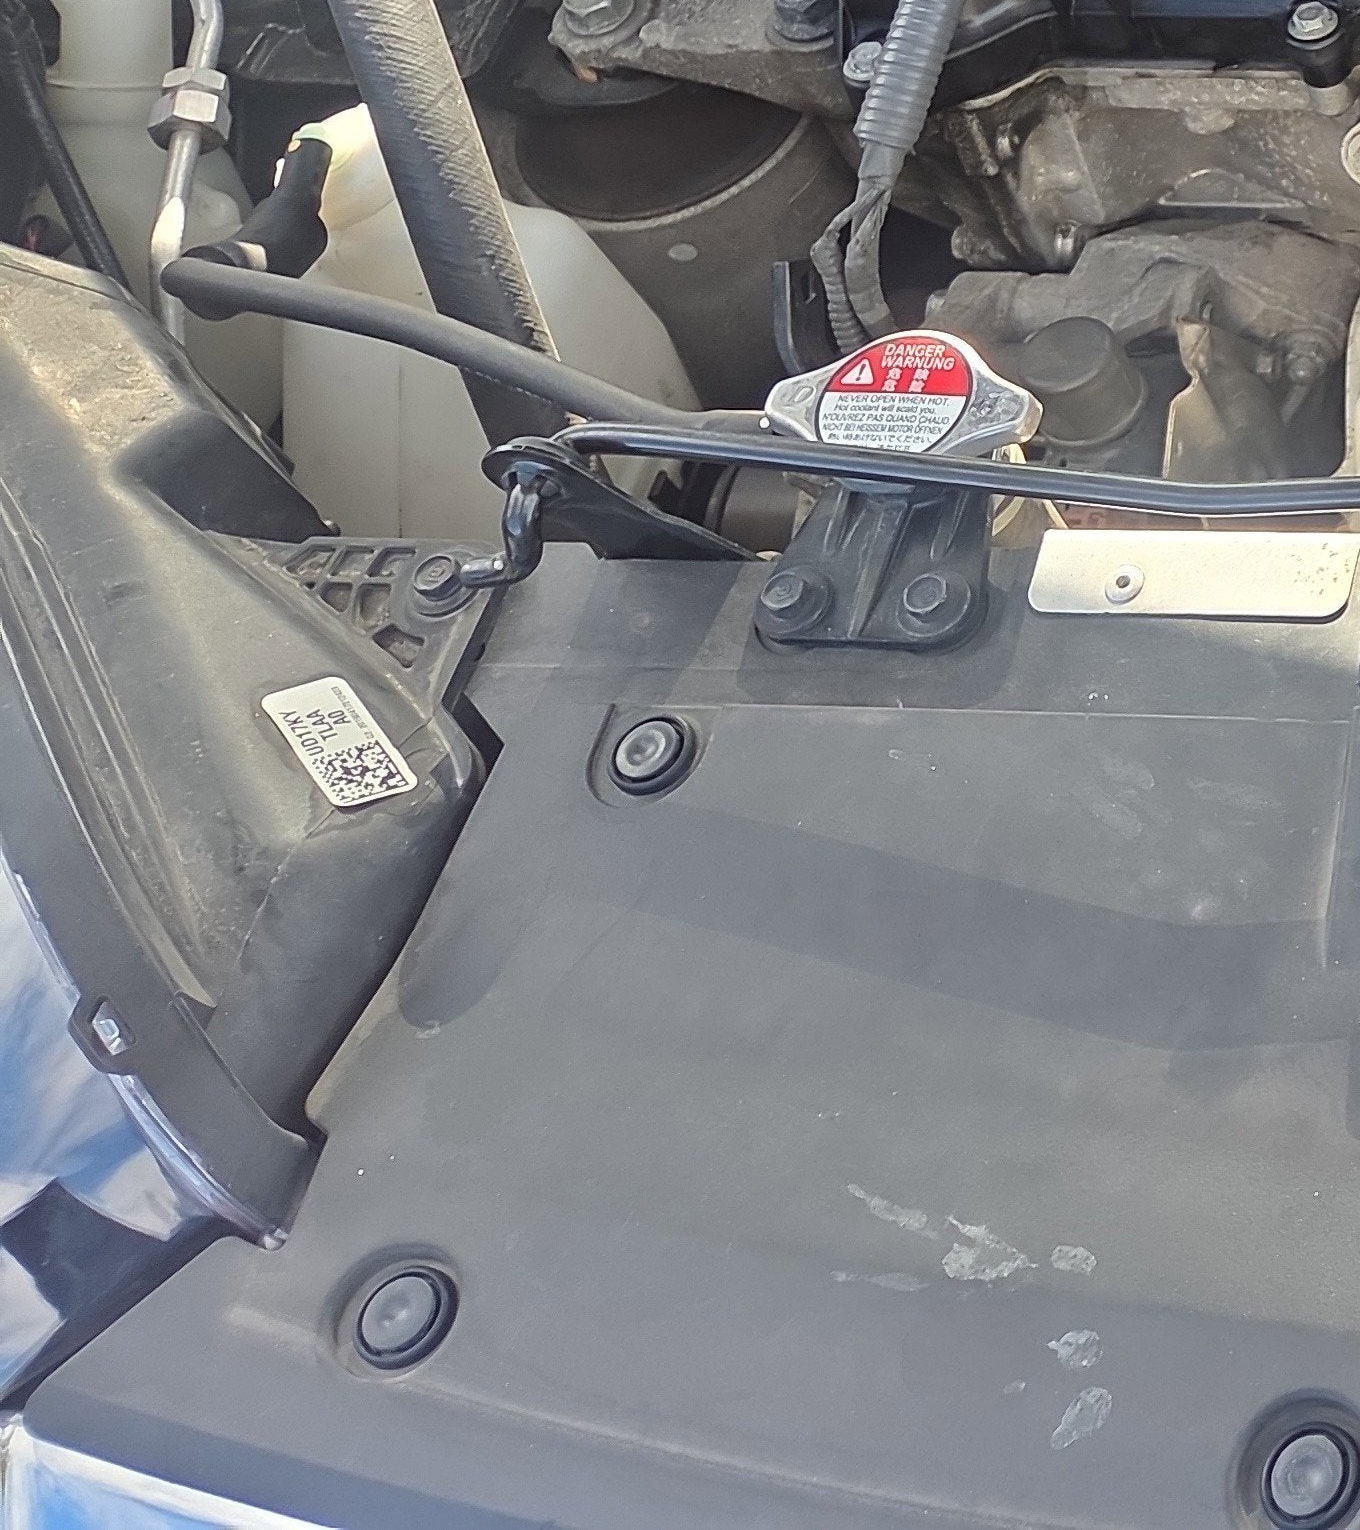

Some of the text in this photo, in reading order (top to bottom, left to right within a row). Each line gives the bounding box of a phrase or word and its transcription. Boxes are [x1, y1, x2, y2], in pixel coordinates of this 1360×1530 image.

[884, 343, 946, 358] DANGER
[881, 355, 955, 370] WARNUNG
[838, 395, 869, 404] NEVER
[870, 395, 897, 404] OPEN
[898, 396, 925, 405] WHEN
[850, 404, 880, 412] coolant
[896, 405, 918, 413] scald
[866, 413, 883, 422] PAS
[885, 414, 917, 423] QUAND
[887, 424, 913, 433] MOTOR
[306, 708, 338, 742] TLAA
[278, 710, 324, 756] UD17KY
